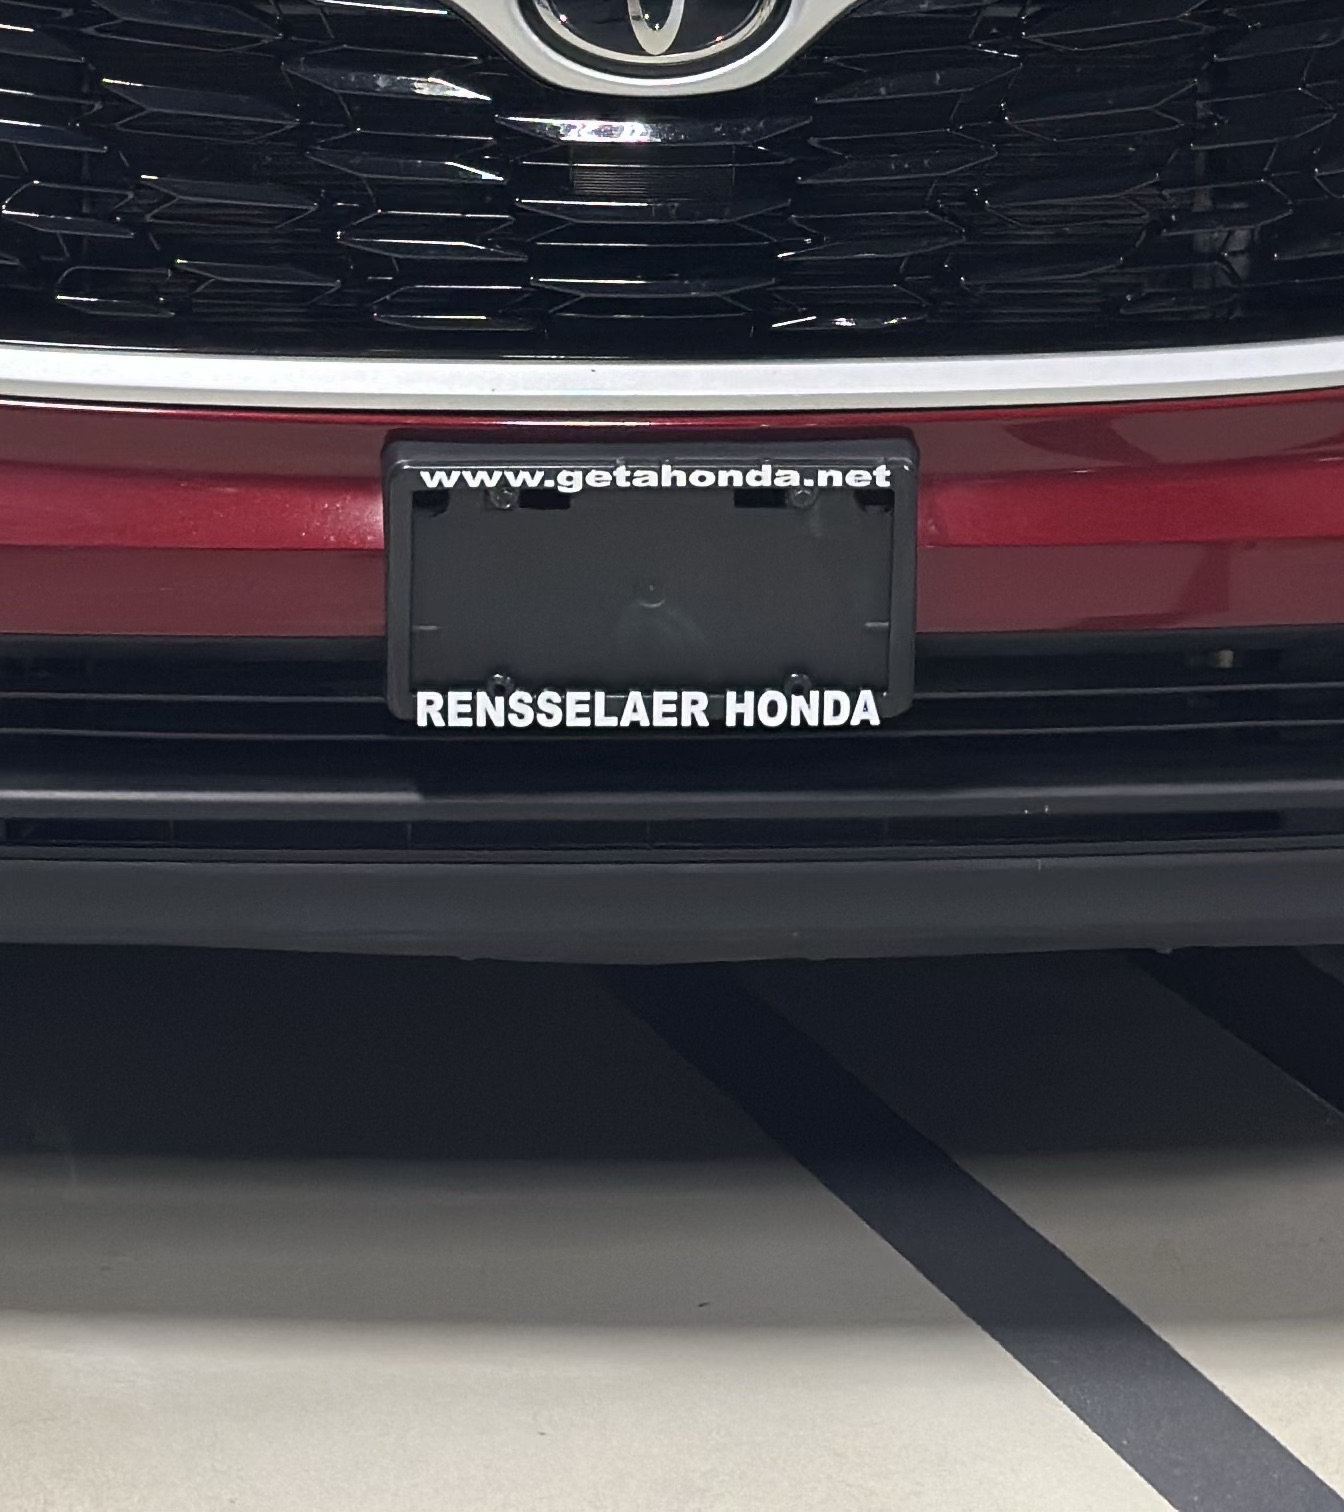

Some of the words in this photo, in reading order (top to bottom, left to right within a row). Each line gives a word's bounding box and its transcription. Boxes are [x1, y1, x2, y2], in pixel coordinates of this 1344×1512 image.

[419, 464, 892, 494] www.getahonda.net
[416, 690, 710, 728] RENSSELAER
[725, 689, 881, 727] HONDA
